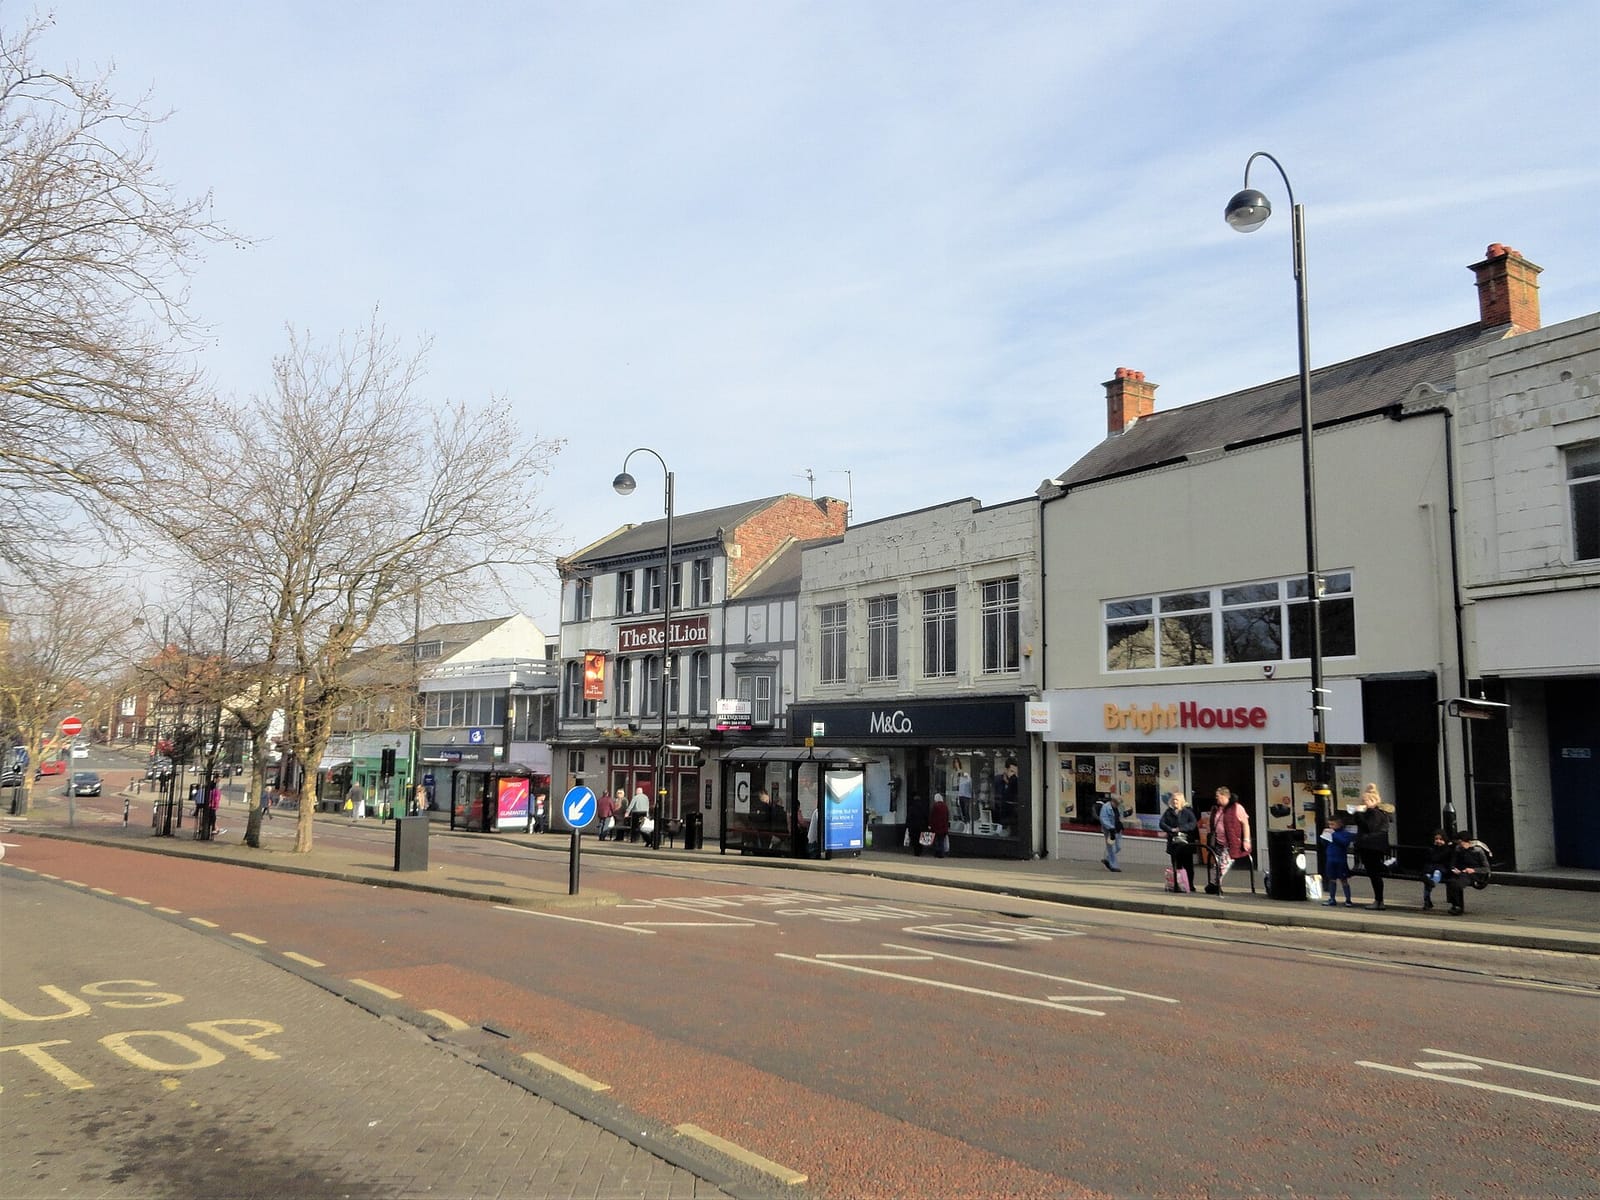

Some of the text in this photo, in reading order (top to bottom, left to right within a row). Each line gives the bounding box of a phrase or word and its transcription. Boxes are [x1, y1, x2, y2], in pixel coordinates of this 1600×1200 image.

[621, 628, 648, 647] The
[674, 624, 707, 642] Lion
[1031, 709, 1048, 717] Bright
[870, 710, 913, 733] M&Co.
[1078, 764, 1094, 774] BEST
[1139, 765, 1157, 775] BEST
[737, 780, 749, 803] C
